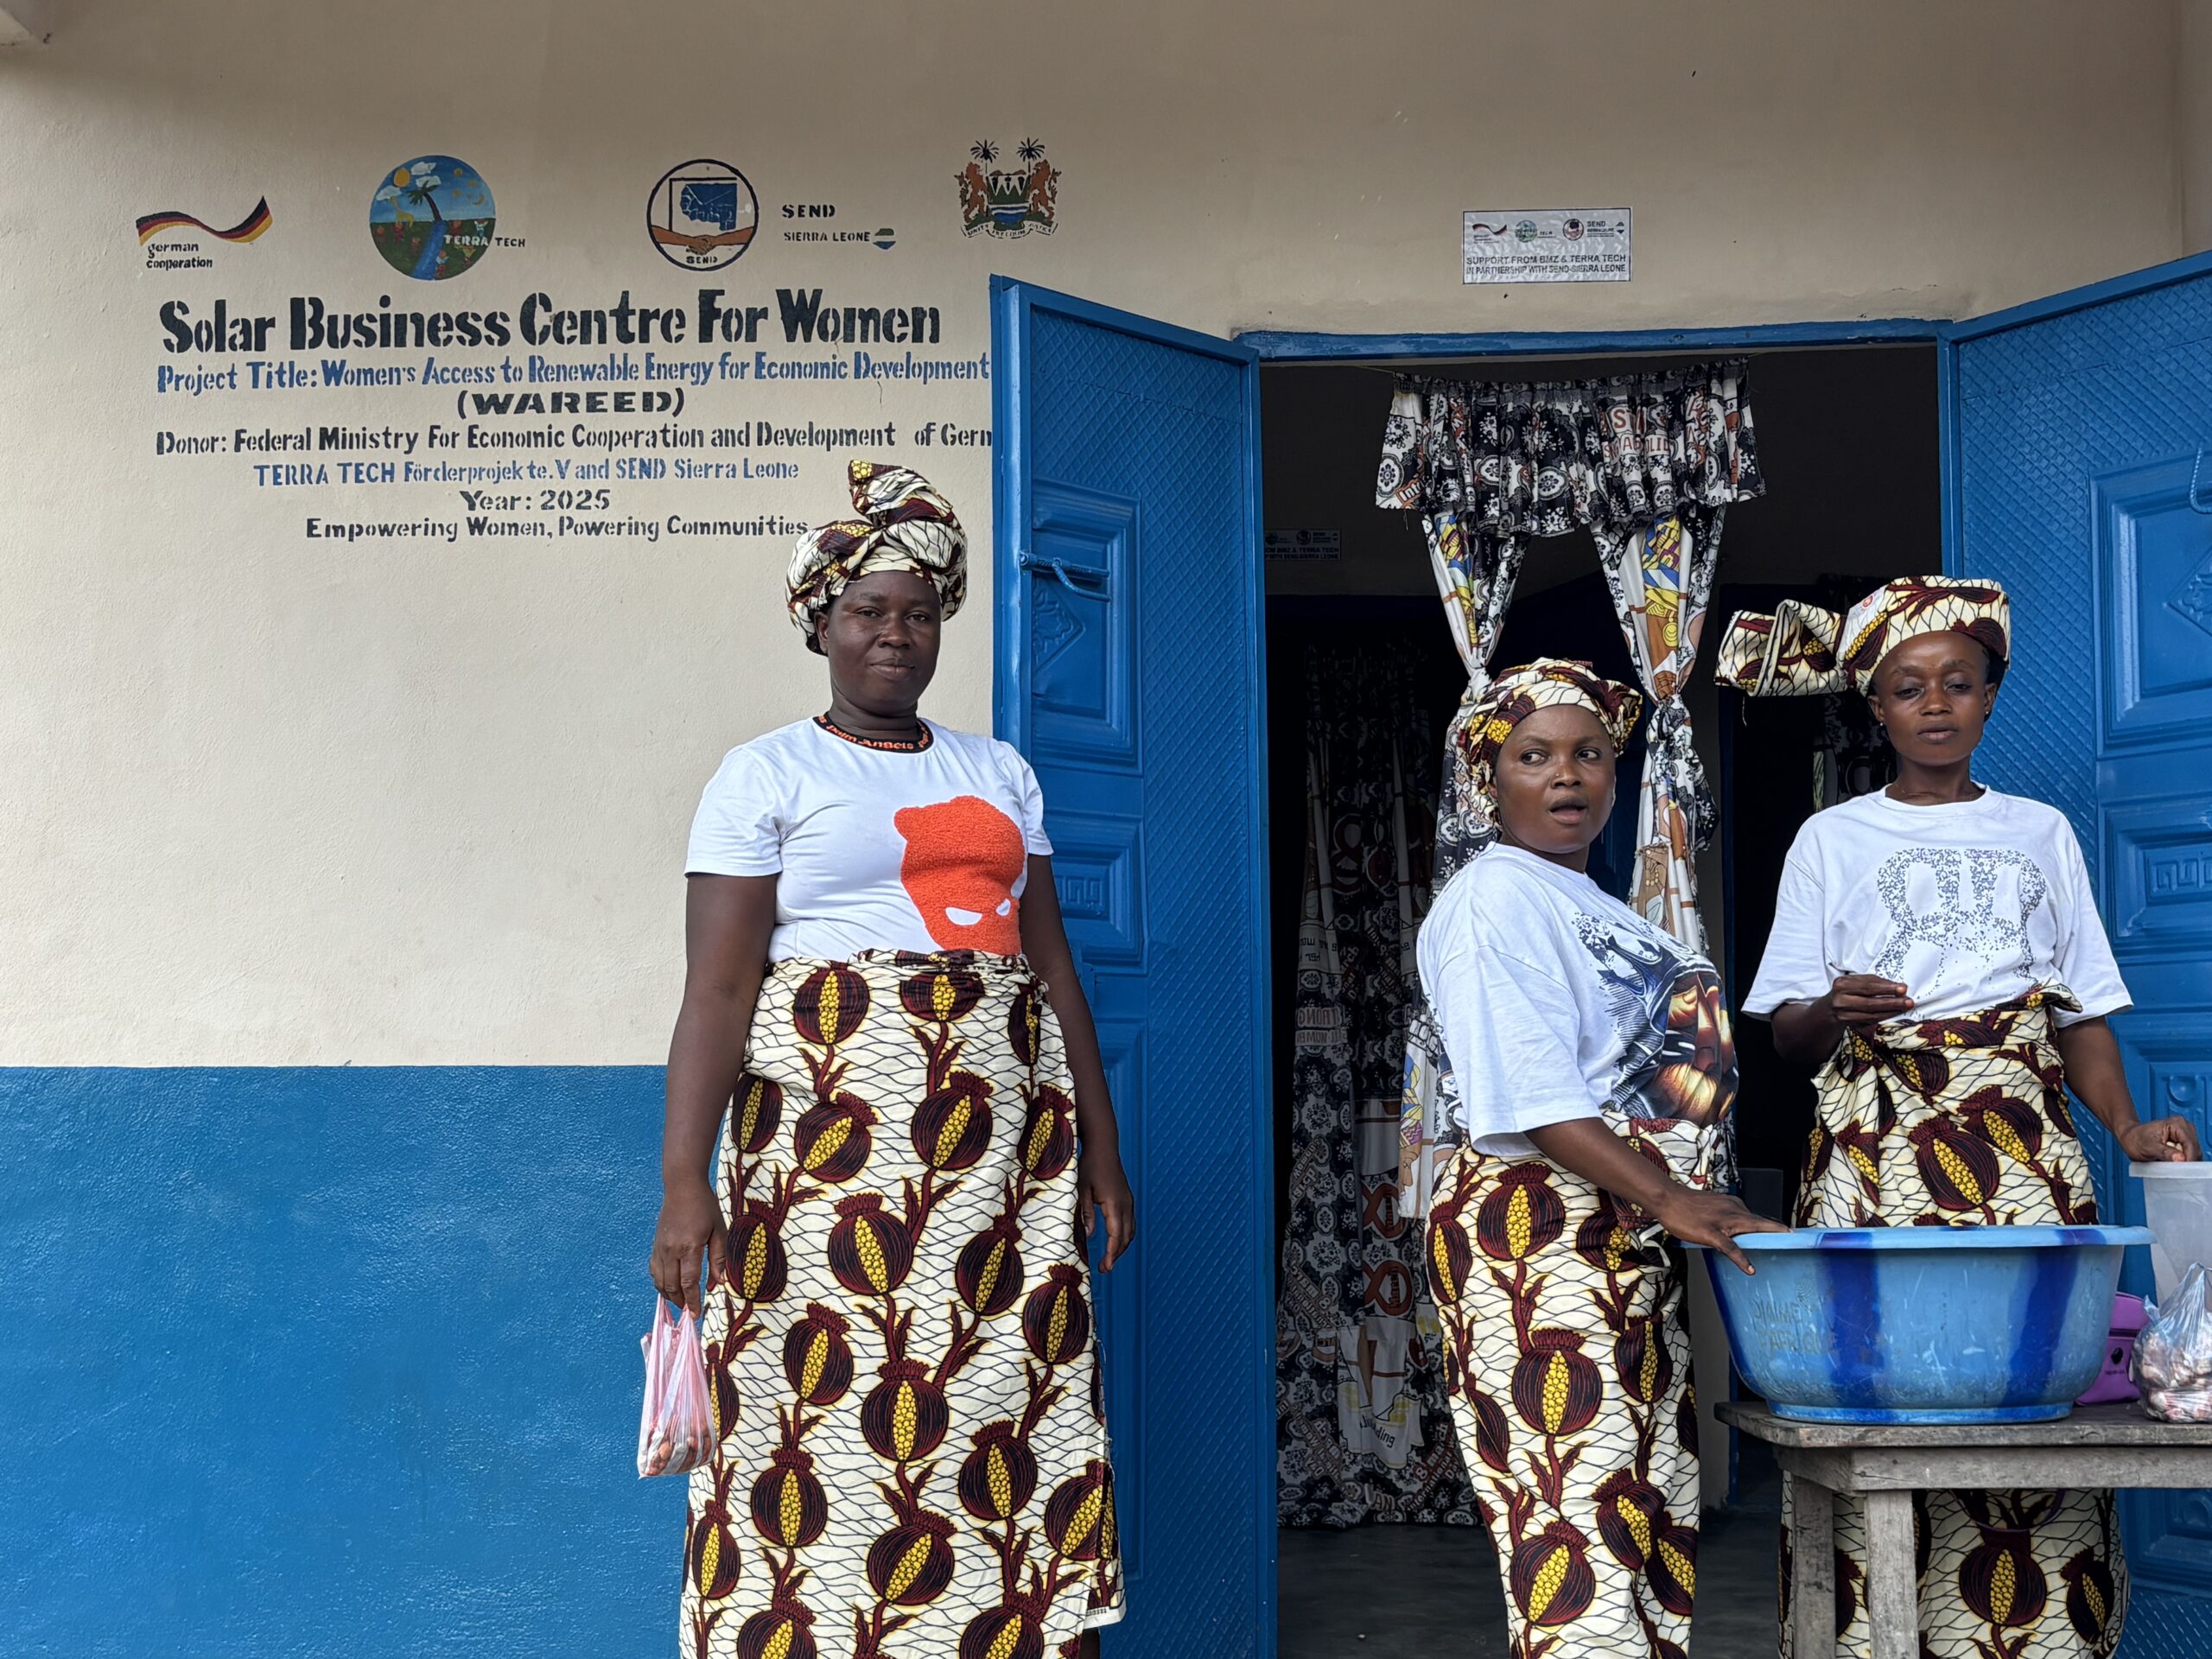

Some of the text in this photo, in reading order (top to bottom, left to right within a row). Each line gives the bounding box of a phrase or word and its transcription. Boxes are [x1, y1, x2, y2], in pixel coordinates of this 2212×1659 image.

[782, 205, 836, 219] SEND
[443, 234, 526, 247] TERRA TECH
[784, 232, 871, 242] SIERRA LEONE
[148, 243, 200, 259] german
[146, 257, 213, 271] cooperation
[685, 256, 718, 264] SEND
[1466, 256, 1510, 265] SUPPORT
[1511, 255, 1537, 264] FROM
[1569, 254, 1600, 263] TERRA
[1602, 254, 1626, 263] TECH
[1476, 265, 1527, 275] PARTNERSHIP
[1529, 264, 1548, 274] WITH
[1600, 264, 1626, 272] LEONE
[160, 289, 940, 353] Solar Business Centre For Women
[158, 363, 238, 396] Project
[246, 361, 318, 389] Title:
[422, 357, 496, 385] Access
[500, 355, 523, 383] to
[529, 353, 639, 384] Renewable
[645, 353, 714, 386] Energy
[719, 352, 751, 380] for
[754, 352, 848, 380] Economic
[854, 352, 990, 385] Development
[458, 388, 684, 419] (WAREED)
[156, 431, 226, 454] Donor:
[234, 426, 311, 452] Federal
[319, 426, 419, 454] Ministry
[429, 425, 460, 448] For
[467, 423, 564, 448] Economic
[572, 423, 703, 452] Cooperation
[711, 422, 750, 448] and
[757, 422, 896, 448] Development
[914, 422, 937, 447] of
[253, 464, 329, 486] TERRA
[337, 462, 395, 484] TECH
[575, 458, 609, 480] and
[616, 457, 666, 480] SEND
[675, 459, 736, 480] Sierra
[744, 458, 798, 479] Leone
[459, 489, 610, 512] Year: 2025
[307, 515, 808, 543] Empowering Women, Powering Communities
